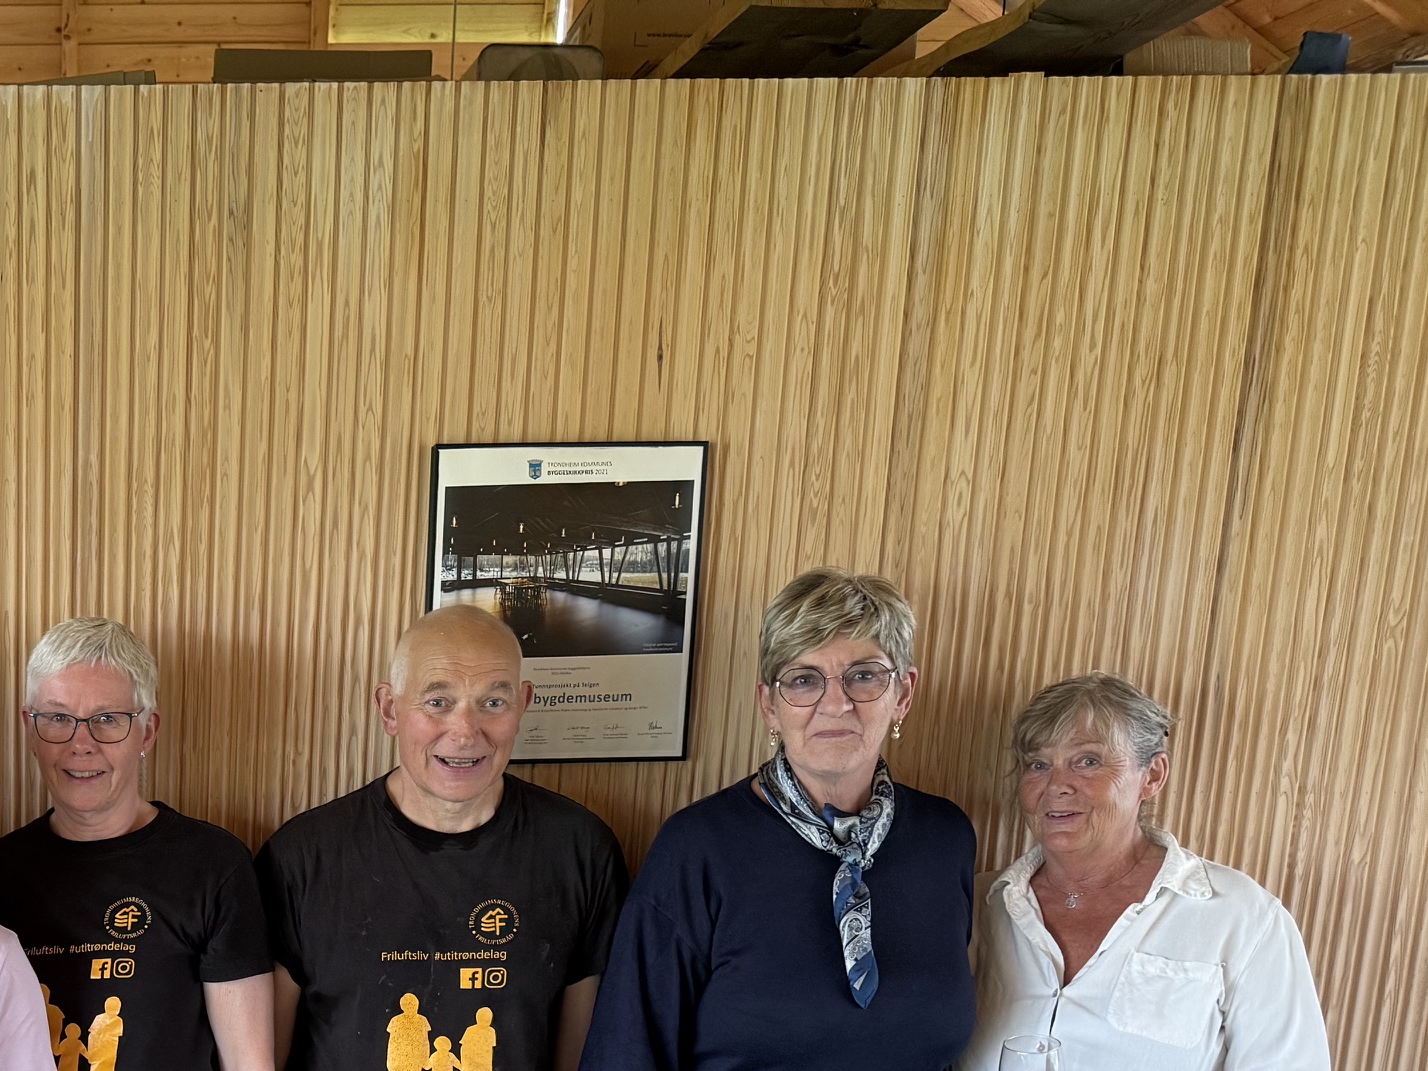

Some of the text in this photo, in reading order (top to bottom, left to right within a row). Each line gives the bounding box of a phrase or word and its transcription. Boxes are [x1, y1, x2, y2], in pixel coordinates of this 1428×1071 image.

[533, 692, 632, 707] bygdemuseum
[69, 941, 136, 953] #utitrøndelag
[381, 949, 507, 961] Friluftsliv #utitrøndelag
